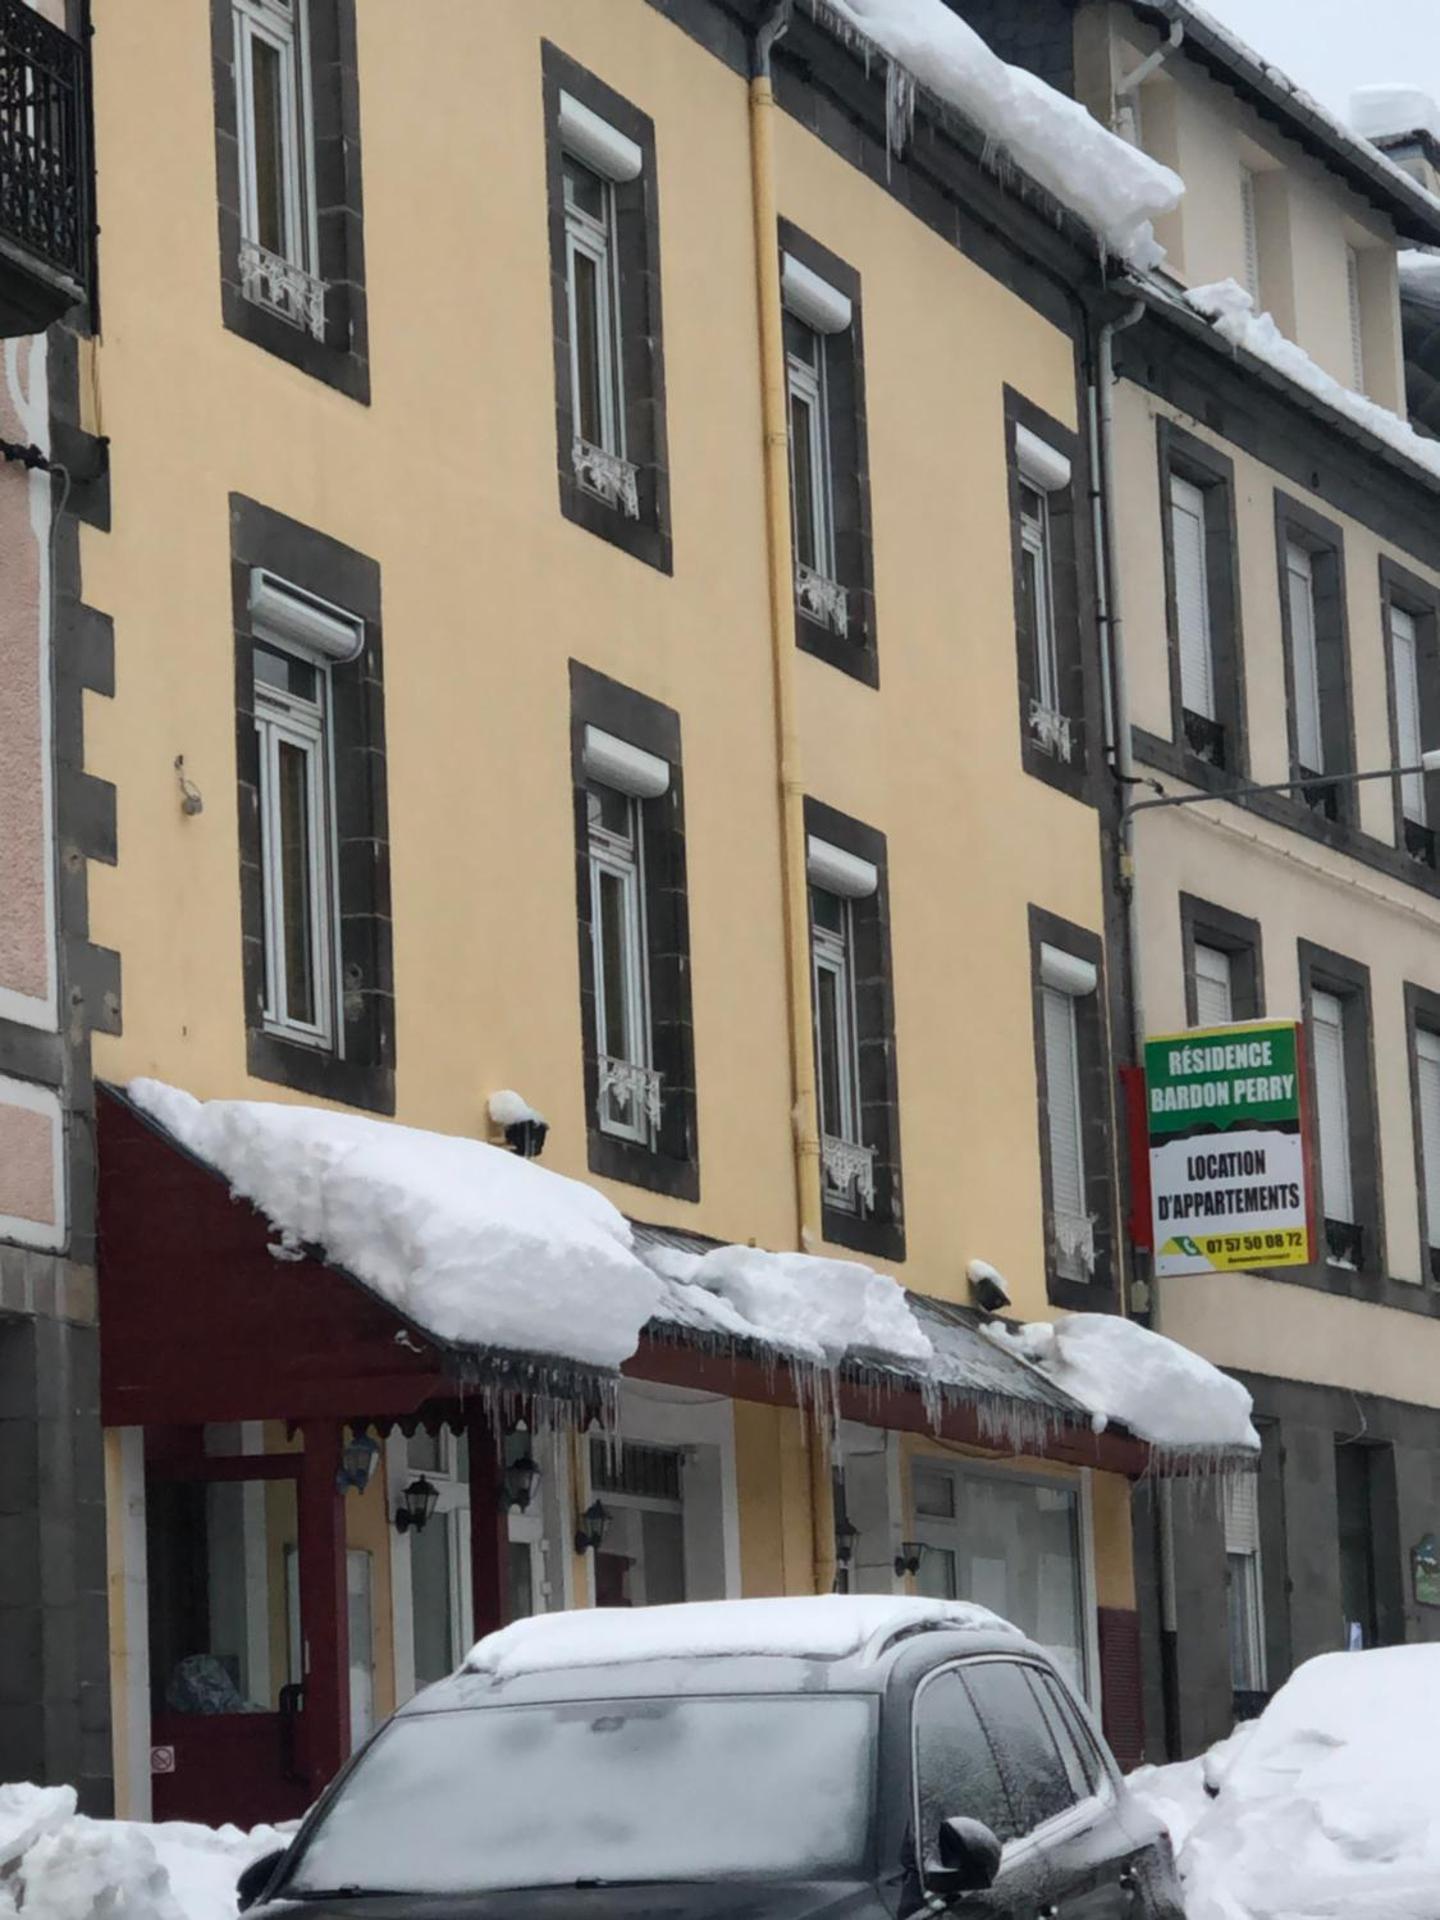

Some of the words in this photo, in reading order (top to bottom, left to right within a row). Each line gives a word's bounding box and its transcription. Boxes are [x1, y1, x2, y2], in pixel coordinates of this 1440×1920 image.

[1168, 1041, 1272, 1076] RÉSIDENCE
[1151, 1081, 1230, 1112] BARDON
[1233, 1074, 1294, 1104] PERRY
[1187, 1149, 1266, 1181] LOCATION
[1158, 1183, 1300, 1221] D'APPARTEMENTS
[1206, 1239, 1222, 1254] 07
[1225, 1238, 1241, 1252] 57
[1243, 1235, 1262, 1250] 50
[1265, 1234, 1284, 1248] 08
[1286, 1232, 1302, 1246] 72
